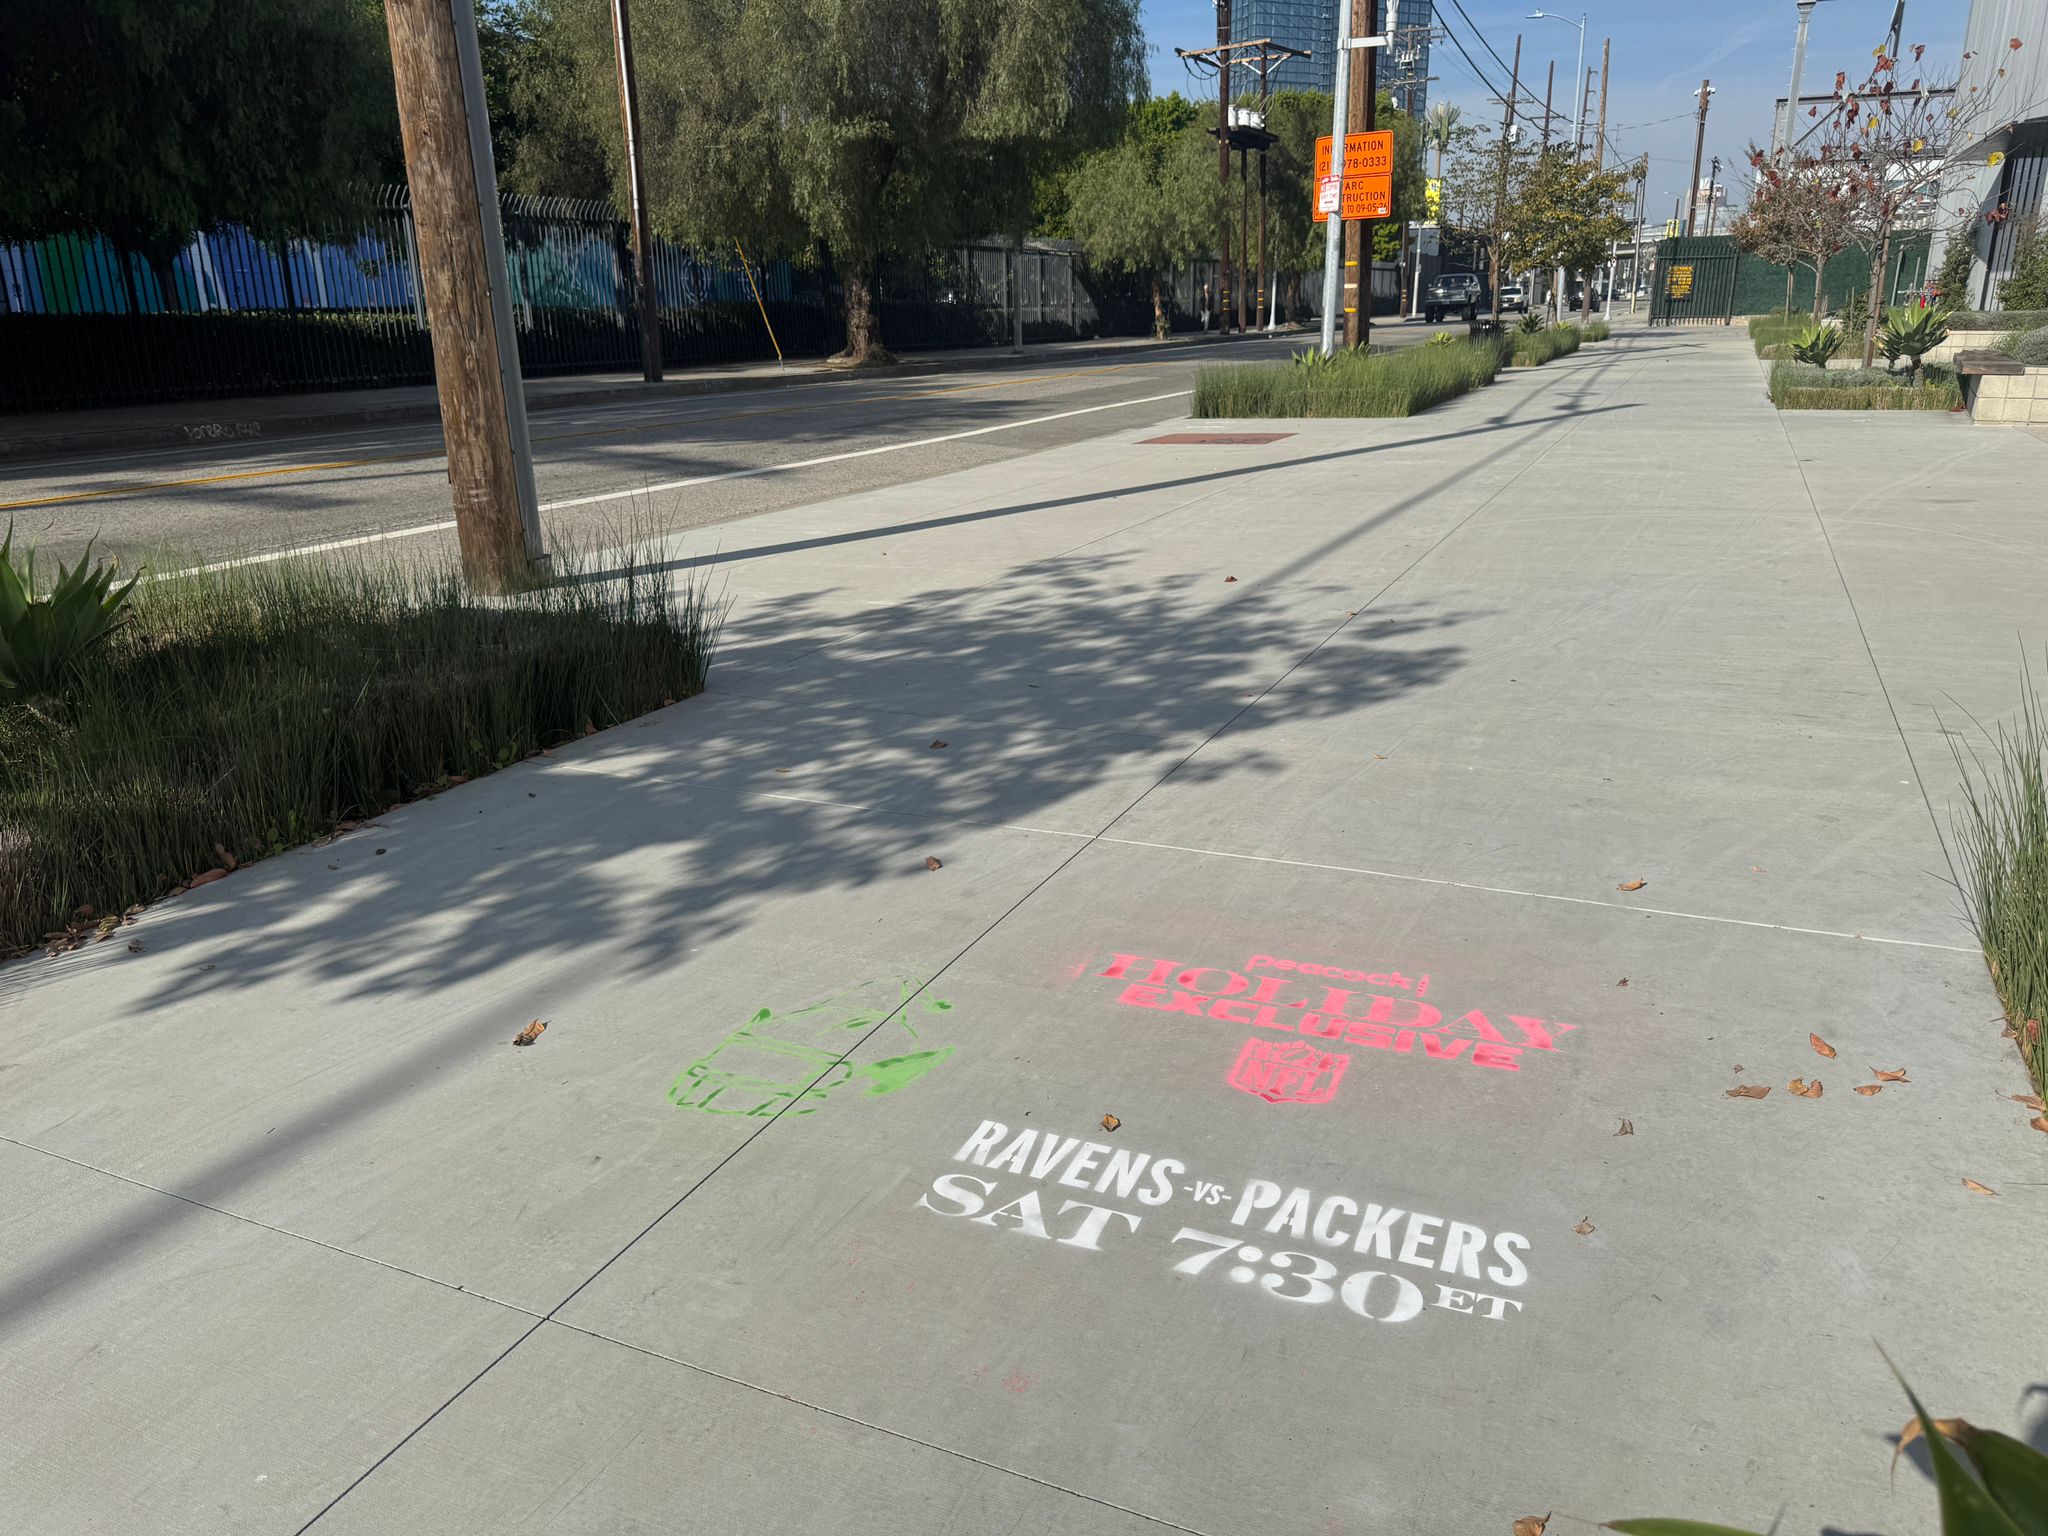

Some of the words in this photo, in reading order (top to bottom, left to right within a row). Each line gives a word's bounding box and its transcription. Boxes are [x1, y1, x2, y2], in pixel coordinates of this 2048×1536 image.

[1322, 140, 1384, 155] INRMATION
[1341, 191, 1386, 203] TRUCTION
[1095, 953, 1578, 1052] HOLIDAY
[1245, 955, 1413, 990] peacock
[1116, 984, 1521, 1071] EXCLUSIVE
[1239, 1058, 1326, 1098] NFL
[953, 1119, 1186, 1206] RAVENS
[1231, 1178, 1532, 1288] PACKERS
[918, 1172, 1143, 1252] SAT
[1169, 1227, 1425, 1324] 7:30
[1429, 1283, 1524, 1322] ET
